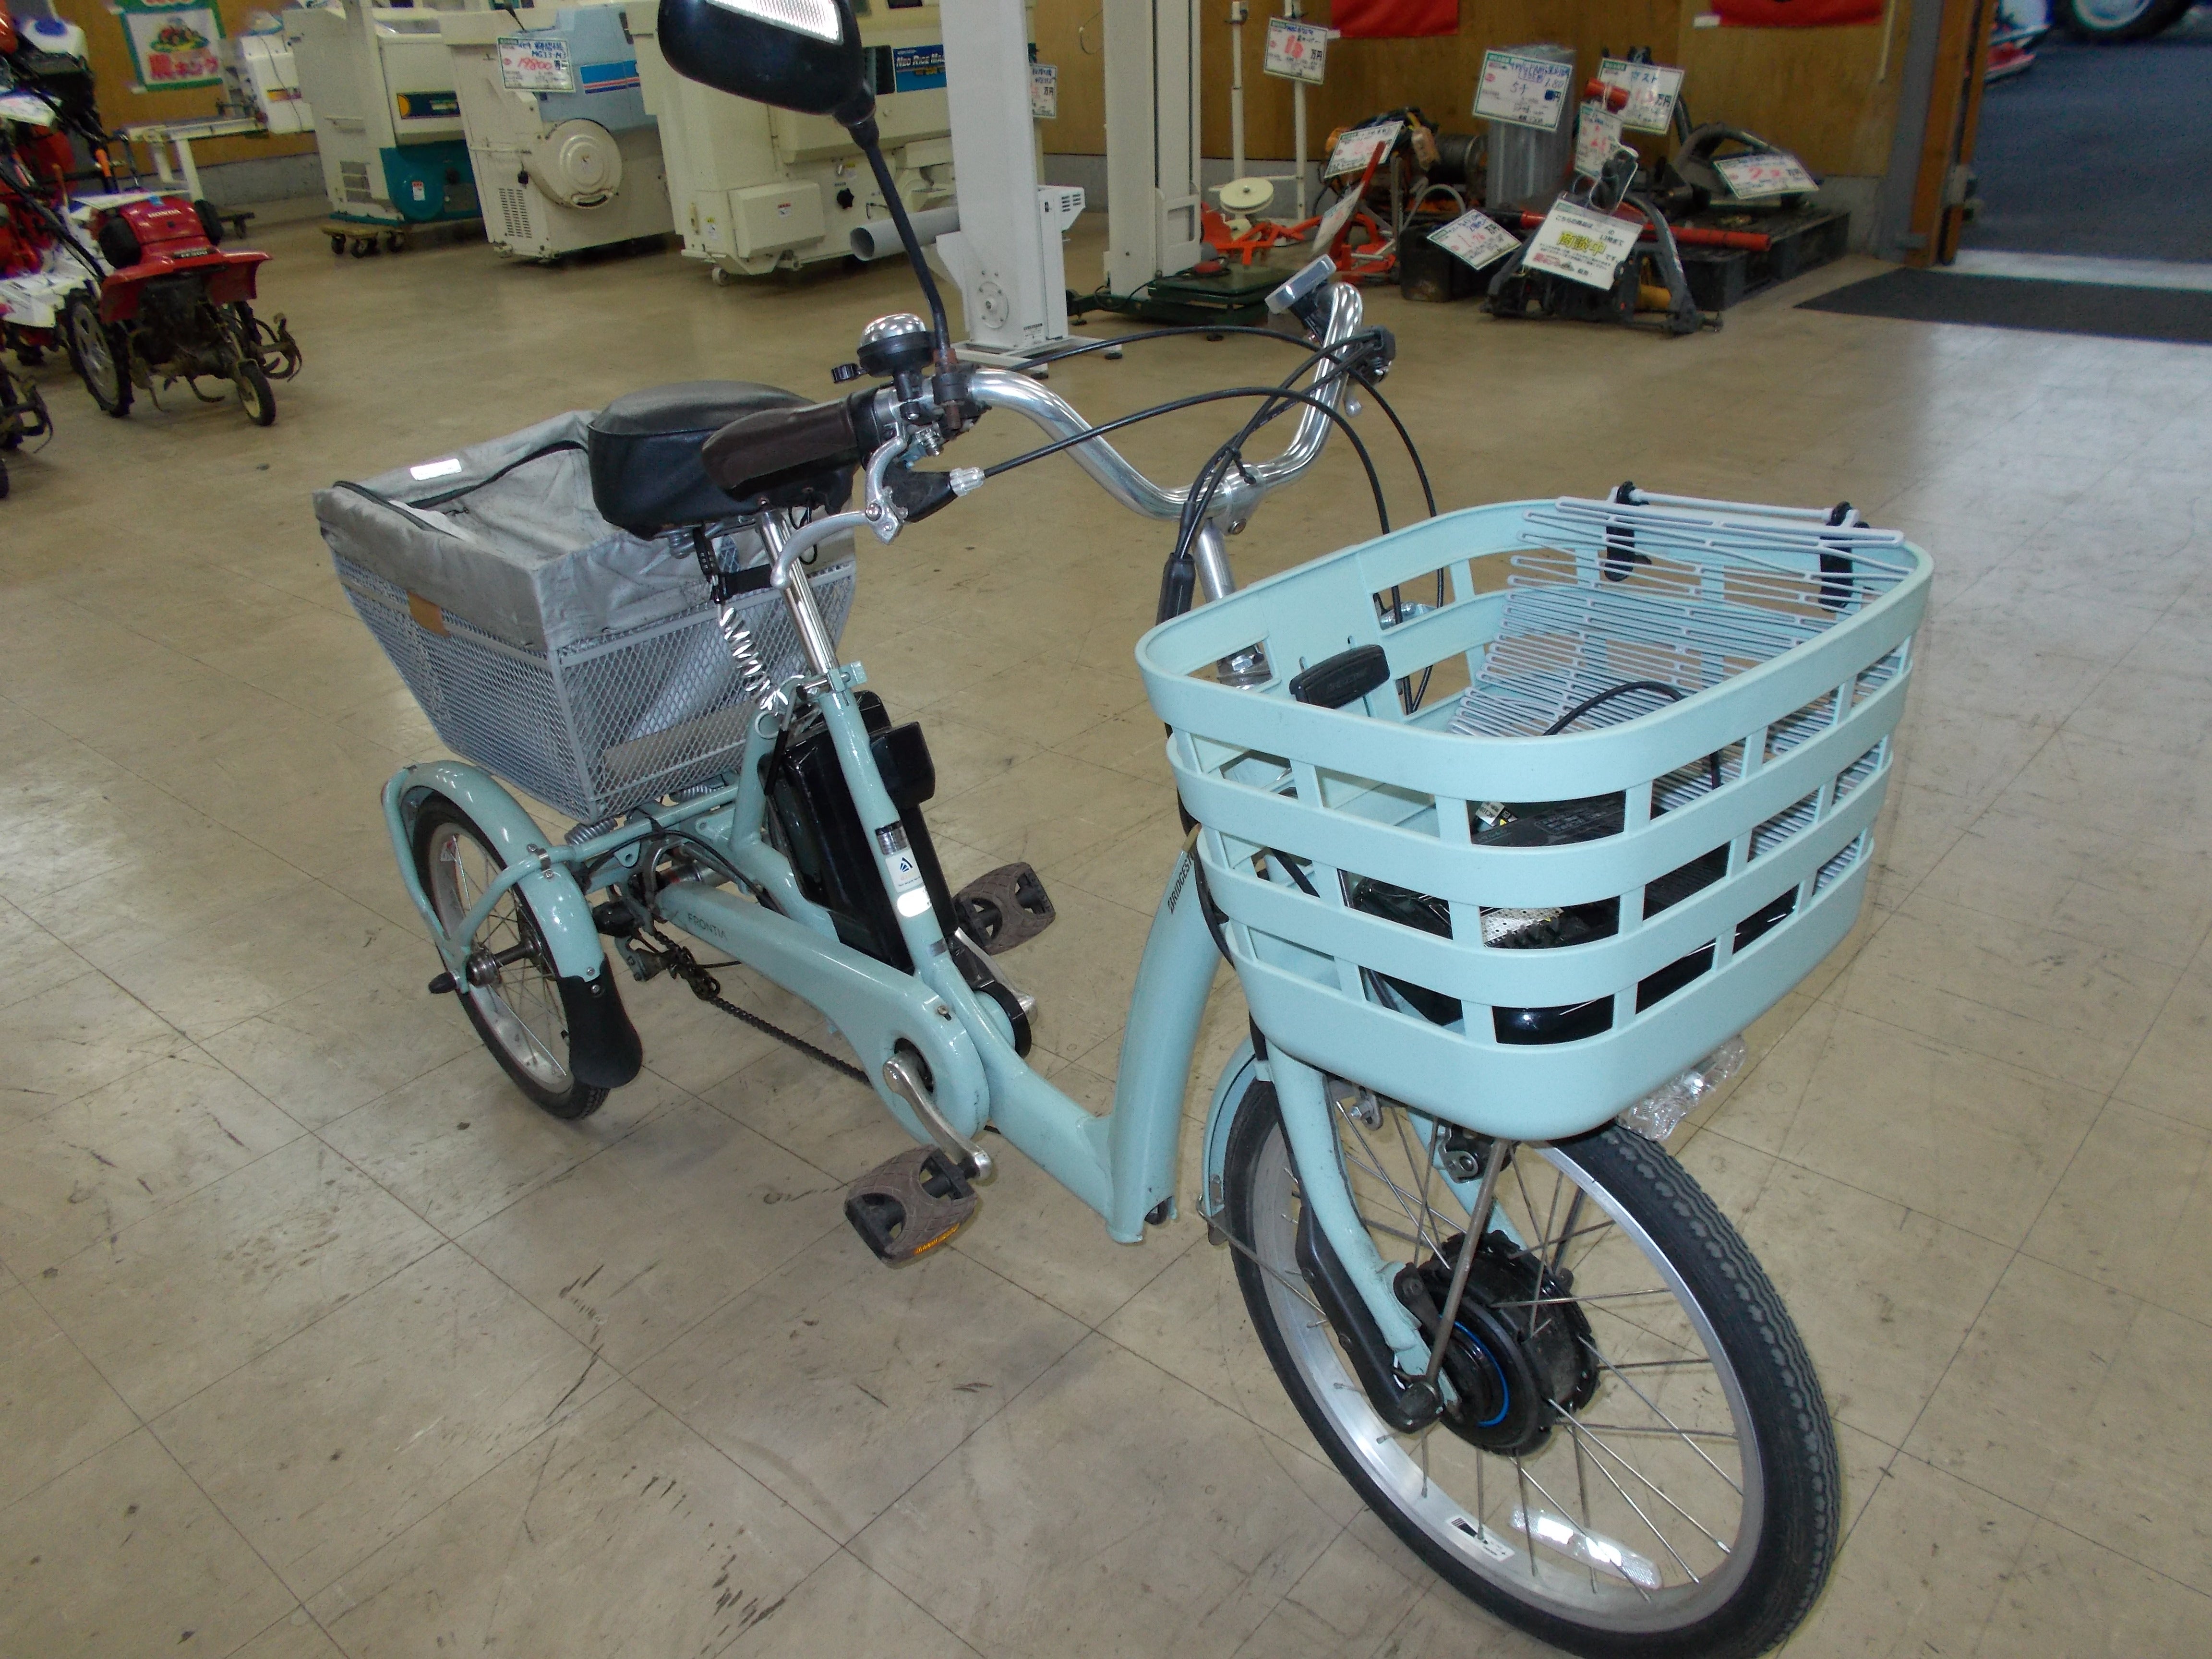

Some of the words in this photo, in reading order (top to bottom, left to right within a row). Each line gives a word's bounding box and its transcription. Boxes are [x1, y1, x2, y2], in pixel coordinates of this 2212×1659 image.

[913, 55, 930, 66] RICE
[147, 209, 181, 218] HONDA
[1556, 231, 1607, 257] 商談中
[687, 913, 728, 941] FRONTIA
